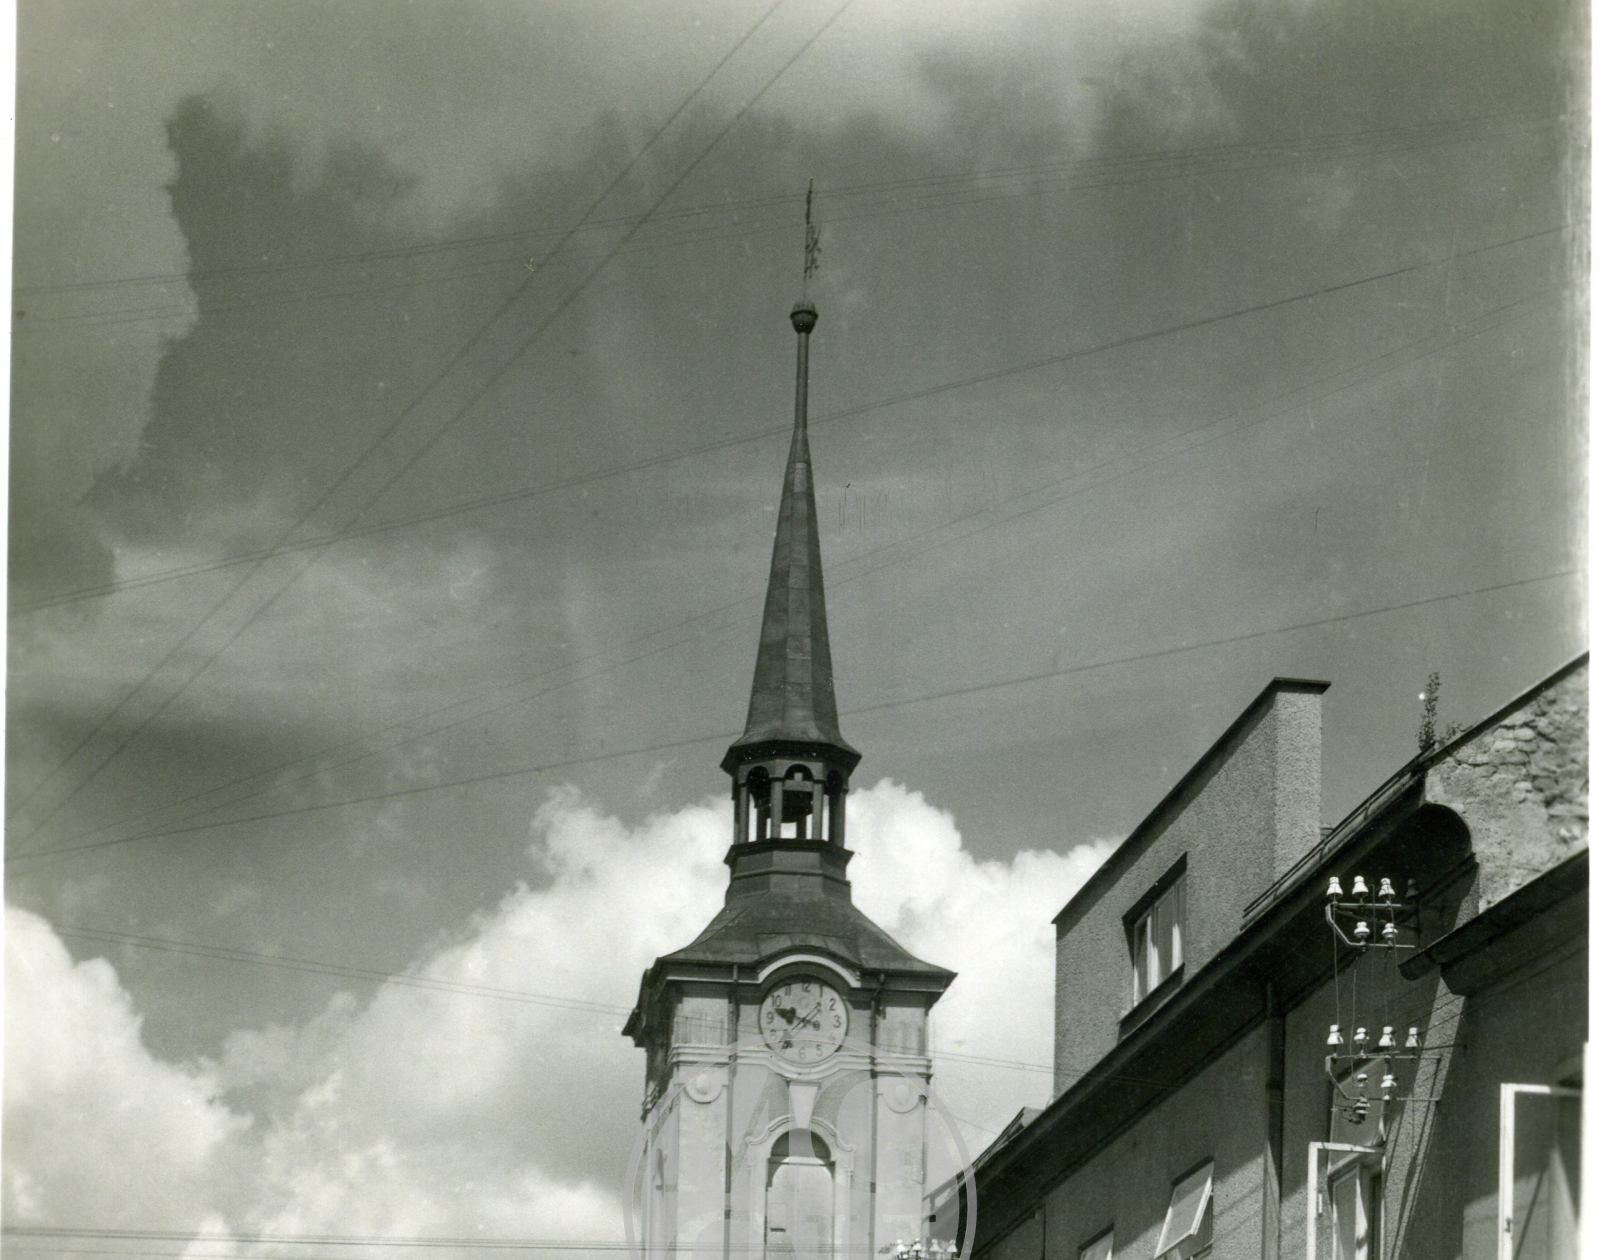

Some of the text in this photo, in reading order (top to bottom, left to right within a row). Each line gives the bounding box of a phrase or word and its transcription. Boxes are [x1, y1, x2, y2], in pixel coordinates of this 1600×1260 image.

[829, 998, 838, 1011] 2
[766, 1011, 774, 1024] 9
[832, 1014, 842, 1029] 3
